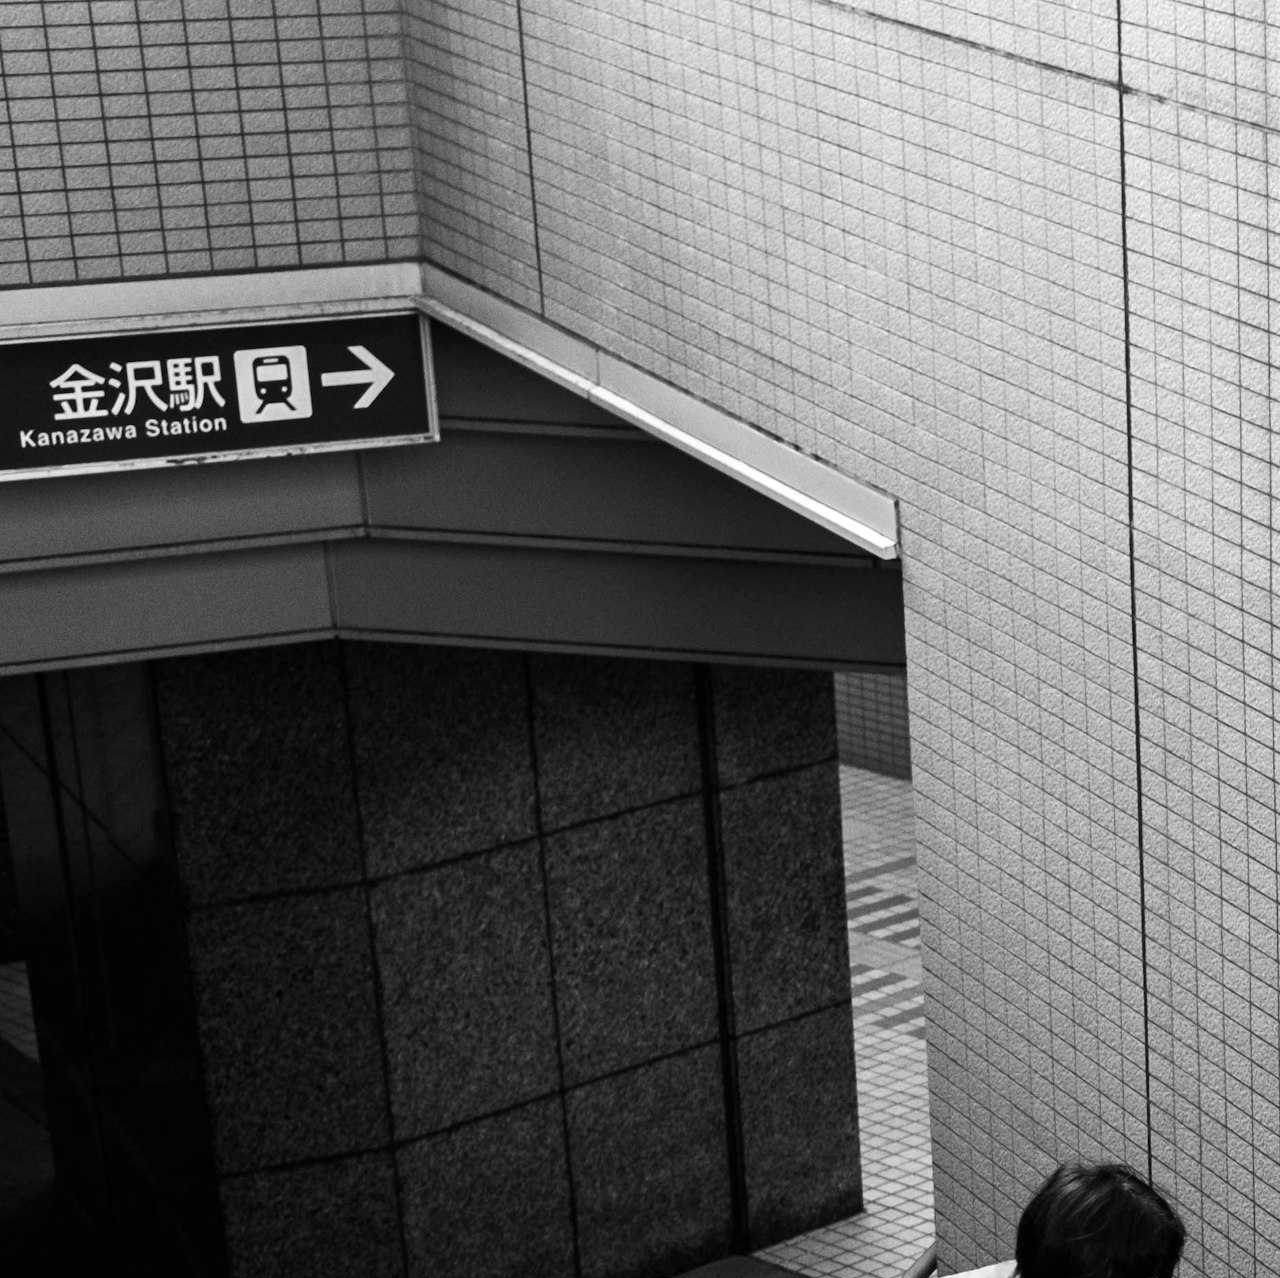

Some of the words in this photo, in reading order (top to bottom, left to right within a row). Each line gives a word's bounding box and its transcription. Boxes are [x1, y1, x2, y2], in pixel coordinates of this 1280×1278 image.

[49, 355, 226, 421] 金沢駅
[19, 424, 138, 448] Kanazawa
[145, 415, 228, 438] Station
